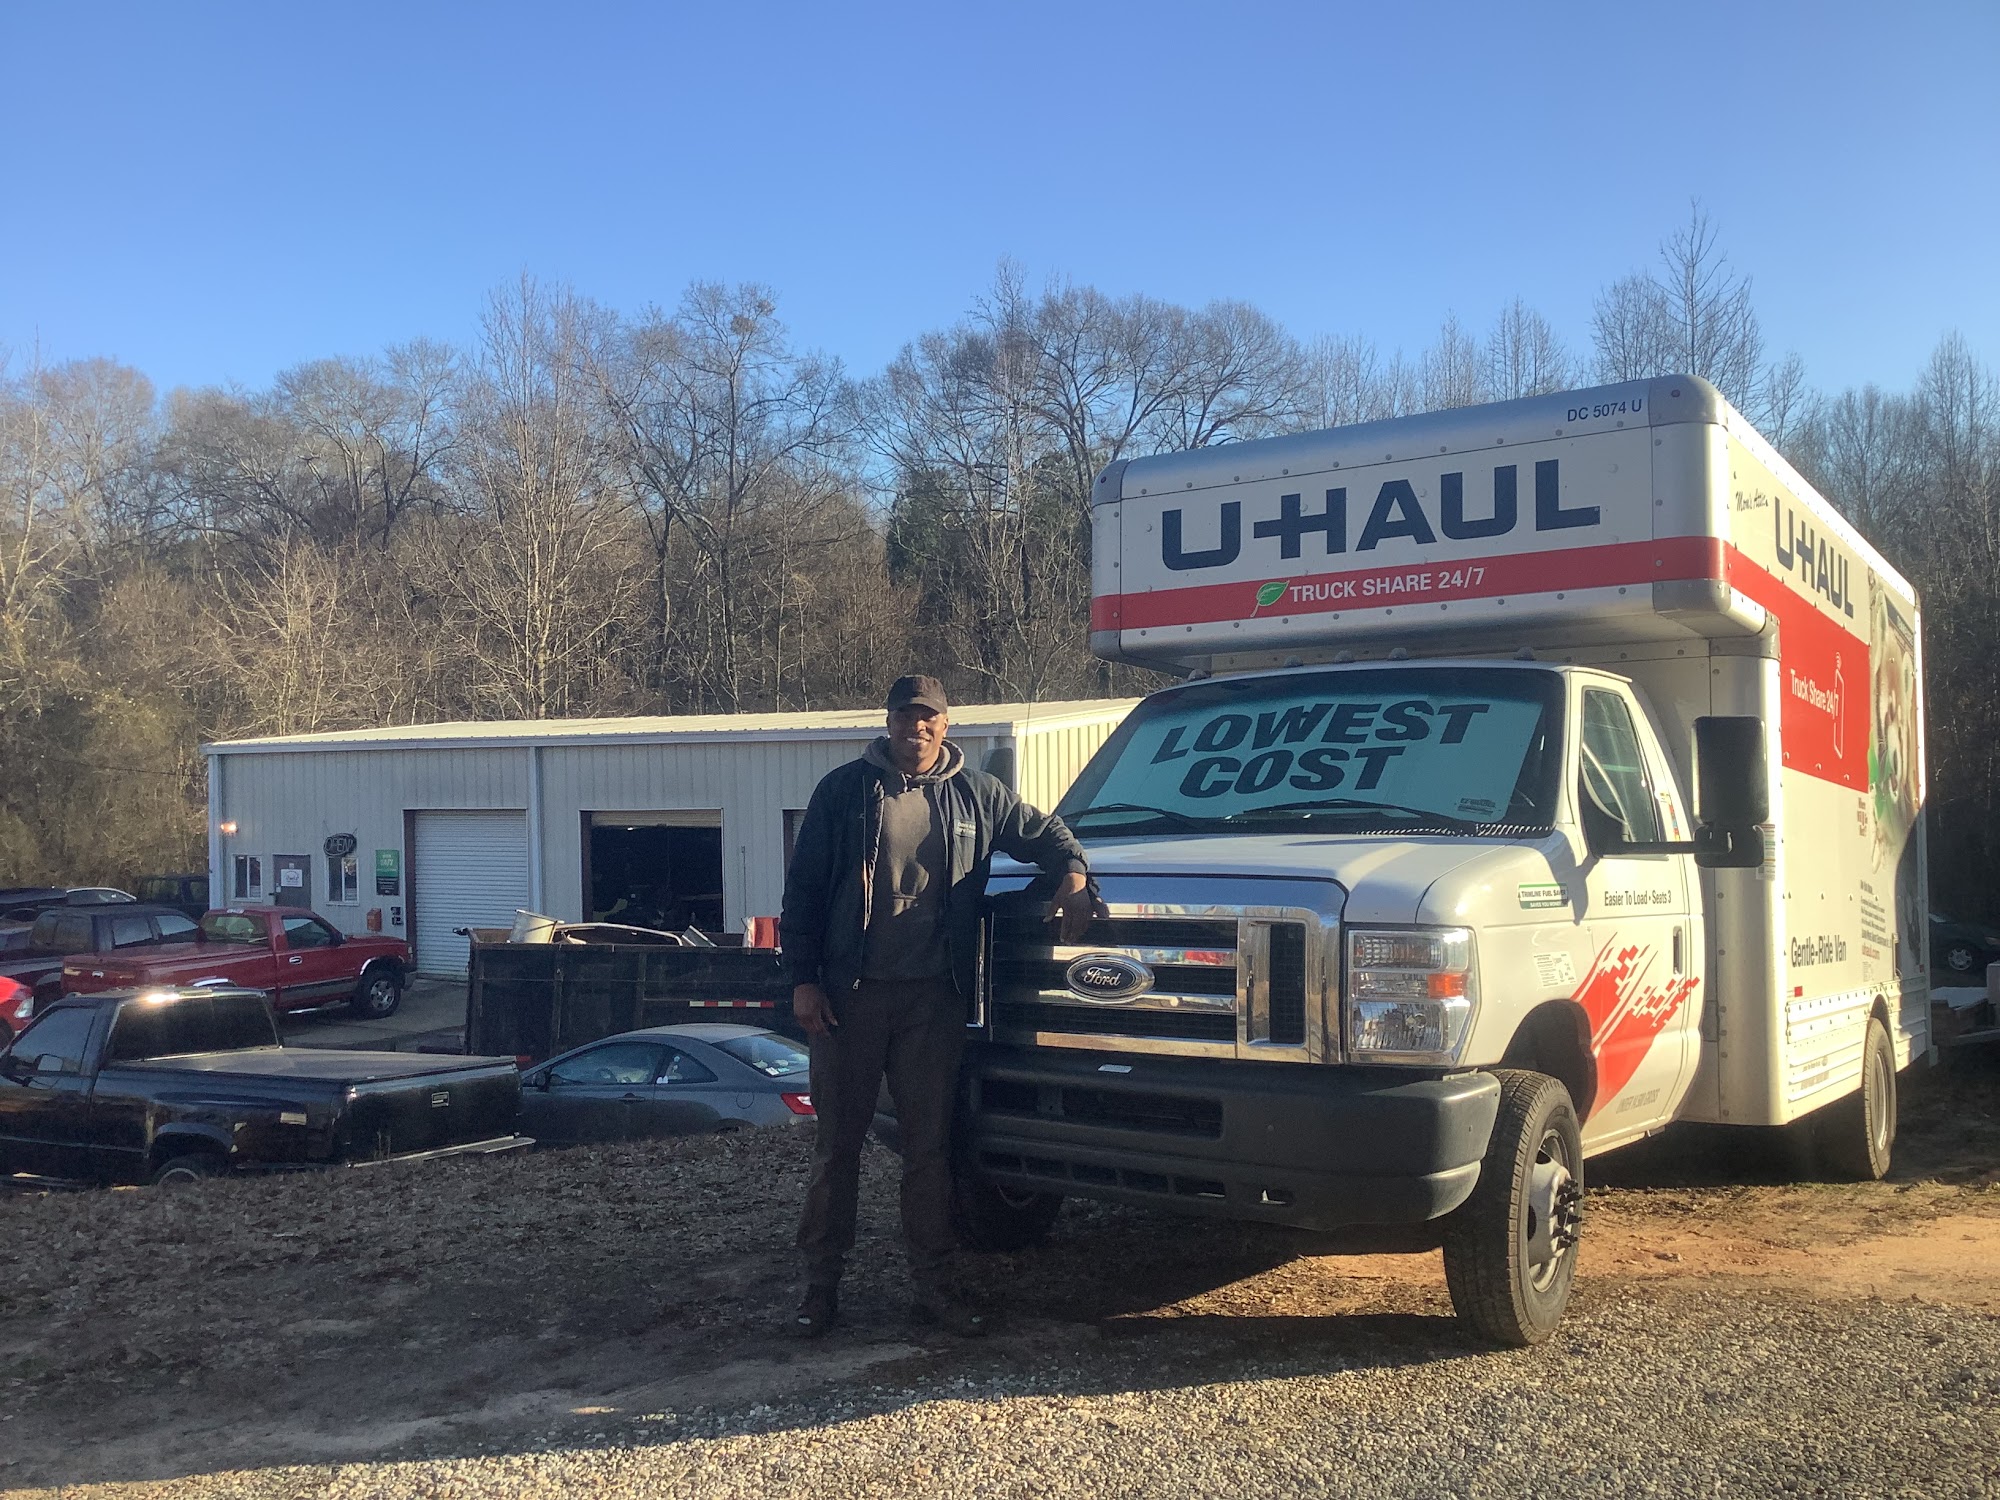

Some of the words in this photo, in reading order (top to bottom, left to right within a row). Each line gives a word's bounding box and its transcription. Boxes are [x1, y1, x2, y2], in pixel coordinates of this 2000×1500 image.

[1567, 407, 1589, 422] DC
[1593, 401, 1627, 418] 5074
[1631, 399, 1642, 412] U
[1162, 459, 1600, 571] U-HAUL
[1289, 580, 1357, 602] TRUCK
[1362, 573, 1432, 596] SHARE
[1438, 566, 1485, 589] 24/7
[1790, 668, 1809, 702] Truck
[1809, 679, 1826, 711] Share
[1826, 688, 1839, 720] 24/7
[1150, 700, 1490, 765] LOWEST
[1179, 746, 1406, 798] COST
[325, 837, 354, 853] OPEN
[1521, 890, 1541, 898] TRIMLINE
[1604, 890, 1624, 907] Easier
[1624, 890, 1633, 906] To
[1633, 889, 1647, 905] Load
[1651, 889, 1667, 905] Seats
[1667, 889, 1672, 904] 3
[1791, 935, 1834, 968] Gentle-Ride
[1834, 934, 1847, 962] Van
[1083, 966, 1122, 987] Ford
